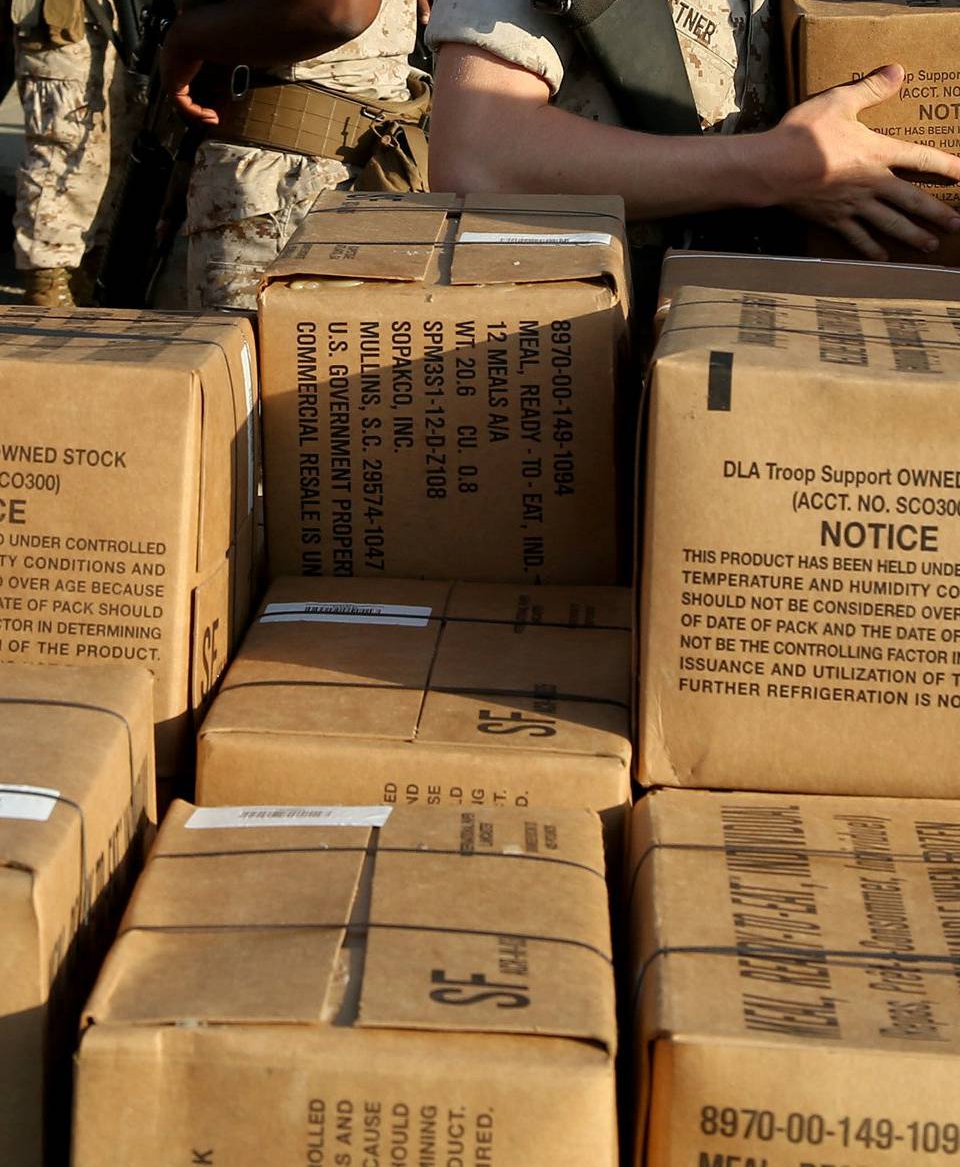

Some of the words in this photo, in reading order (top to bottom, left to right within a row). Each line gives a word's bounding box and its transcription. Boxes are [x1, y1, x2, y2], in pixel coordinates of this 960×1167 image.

[897, 84, 939, 101] (ACCT.
[904, 125, 925, 135] HAS
[928, 125, 955, 135] BEEN
[323, 321, 348, 357] U.S.
[454, 320, 475, 351] WT.
[486, 320, 507, 343] 12
[515, 320, 540, 375] MEAL,
[357, 321, 381, 411] MULLINS,
[388, 320, 413, 409] SOPAKCO,
[454, 357, 476, 396] 20.6
[485, 348, 508, 408] MEALS
[296, 321, 319, 447] COMMERCIAL
[421, 320, 447, 500] SPM3S1-12-D-Z108
[549, 320, 574, 497] 8970-00-149-1094
[325, 364, 352, 493] GOVERNMENT
[360, 417, 382, 452] S.C.
[393, 416, 414, 454] INC.
[456, 425, 478, 454] CU.
[485, 412, 510, 443] A/A
[62, 447, 126, 468] STOCK
[298, 453, 320, 522] RESALE
[456, 465, 478, 493] 0.8
[723, 459, 760, 479] DLA
[765, 462, 816, 486] Troop
[820, 464, 892, 488] Support
[361, 458, 384, 575] 29574-1047
[792, 490, 851, 513] (ACCT.
[857, 494, 890, 513] NO.
[9, 533, 61, 549] UNDER
[65, 537, 166, 555] CONTROLLED
[300, 526, 322, 544] IS
[820, 520, 938, 552] NOTICE
[23, 555, 125, 574] CONDITIONS
[131, 562, 165, 576] AND
[681, 548, 716, 564] THIS
[720, 550, 795, 568] PRODUCT
[797, 554, 828, 570] HAS
[832, 556, 873, 572] BEEN
[876, 558, 917, 574] HELD
[8, 575, 49, 590] OVER
[54, 578, 86, 593] AGE
[91, 580, 164, 598] BECAUSE
[681, 569, 804, 590] TEMPERATURE
[808, 577, 843, 593] AND
[849, 579, 931, 597] HUMIDITY
[27, 598, 48, 611] OF
[52, 599, 94, 615] PACK
[98, 602, 163, 618] SHOULD
[681, 591, 746, 609] SHOULD
[750, 595, 784, 611] NOT
[787, 597, 809, 613] BE
[812, 599, 916, 618] CONSIDERED
[37, 619, 52, 633] IN
[57, 621, 161, 640] DETERMINING
[680, 612, 702, 627] OF
[706, 614, 746, 631] DATE
[750, 617, 772, 632] OF
[776, 619, 818, 635] PACK
[821, 622, 856, 638] AND
[860, 624, 892, 639] THE
[896, 626, 936, 642] DATE
[8, 639, 30, 653] OF
[36, 641, 69, 656] THE
[75, 643, 160, 661] PRODUCT.
[680, 634, 712, 650] NOT
[715, 637, 736, 652] BE
[738, 638, 770, 654] THE
[773, 640, 883, 661] CONTROLLING
[887, 647, 948, 664] FACTOR
[679, 656, 765, 675] ISSUANCE
[770, 662, 806, 677] AND
[813, 664, 916, 684] UTILIZATION
[922, 671, 946, 686] OF
[679, 677, 760, 696] FURTHER
[766, 683, 908, 705] REFRIGERATION
[915, 692, 931, 707] IS
[477, 709, 558, 738] SF
[429, 969, 532, 1011] SF
[336, 1099, 354, 1146] AND
